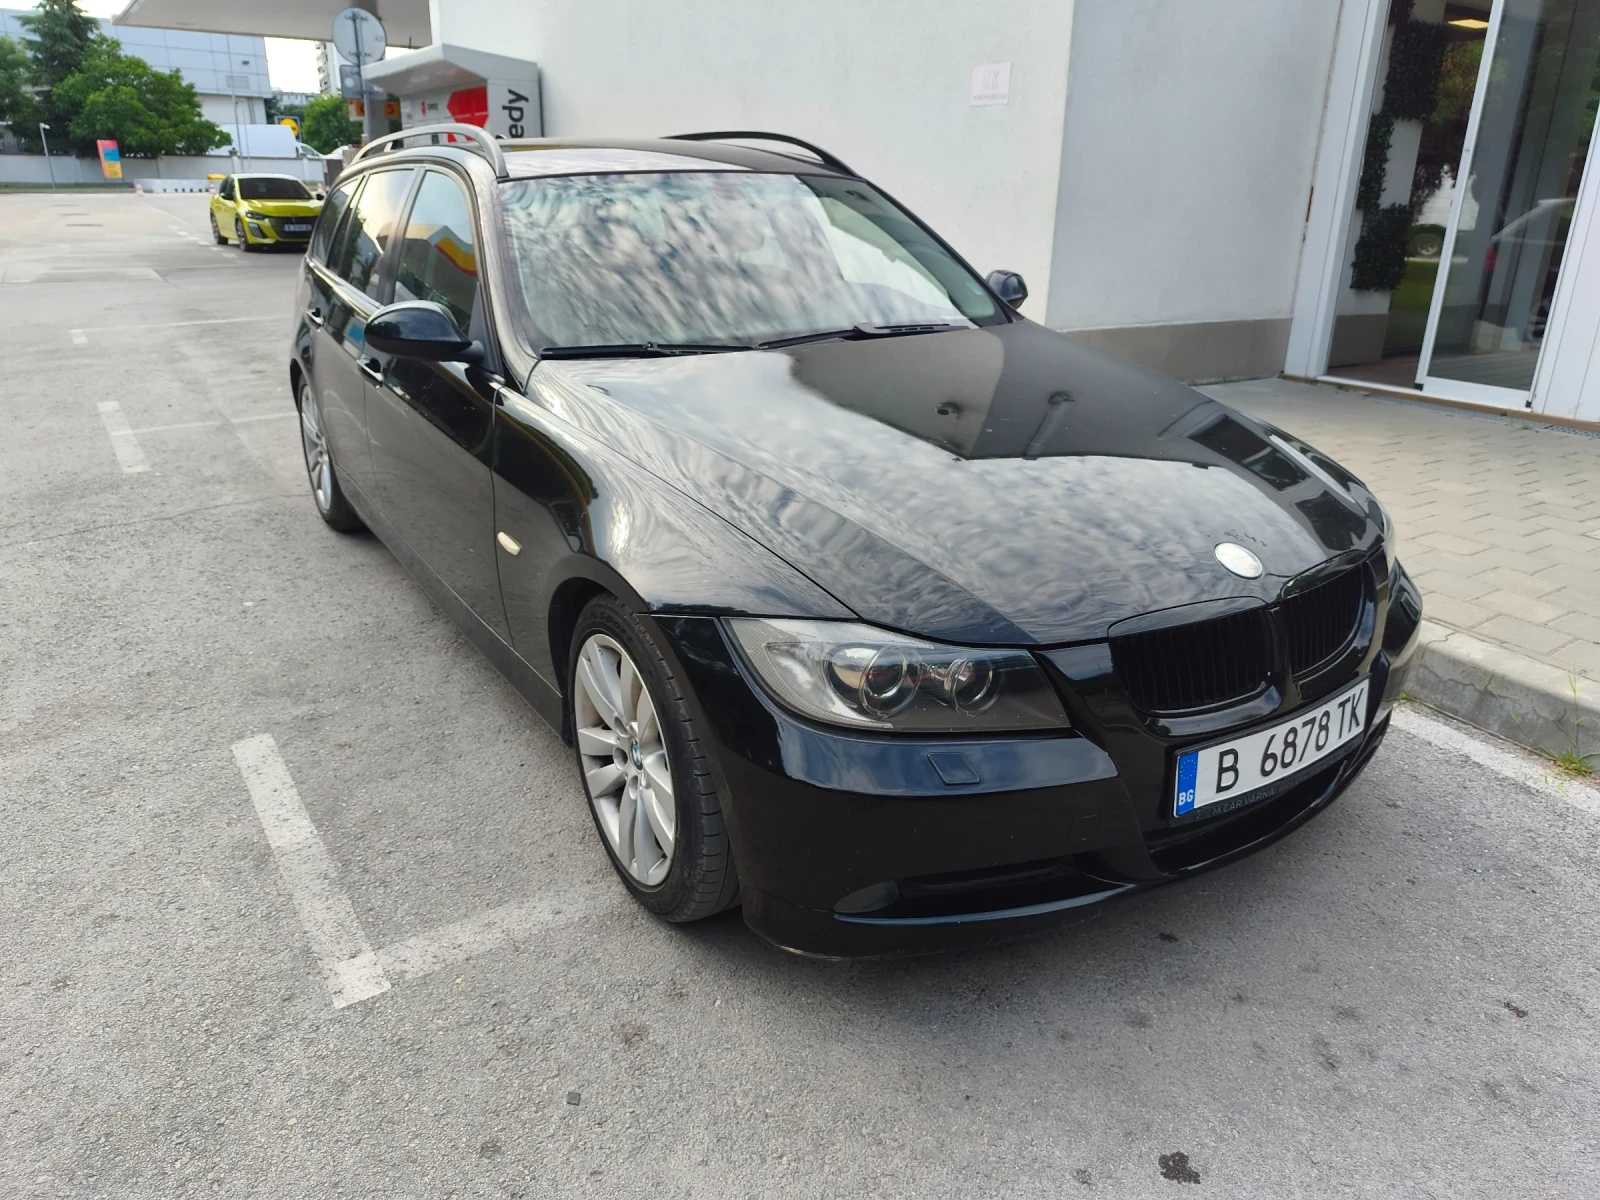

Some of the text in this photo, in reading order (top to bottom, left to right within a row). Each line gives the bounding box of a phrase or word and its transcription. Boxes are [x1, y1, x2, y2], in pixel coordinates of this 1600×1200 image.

[1215, 748, 1239, 794] B
[1260, 710, 1331, 777] 6878
[1337, 687, 1365, 741] TK
[1178, 789, 1194, 806] BG
[1243, 787, 1276, 806] VARNA
